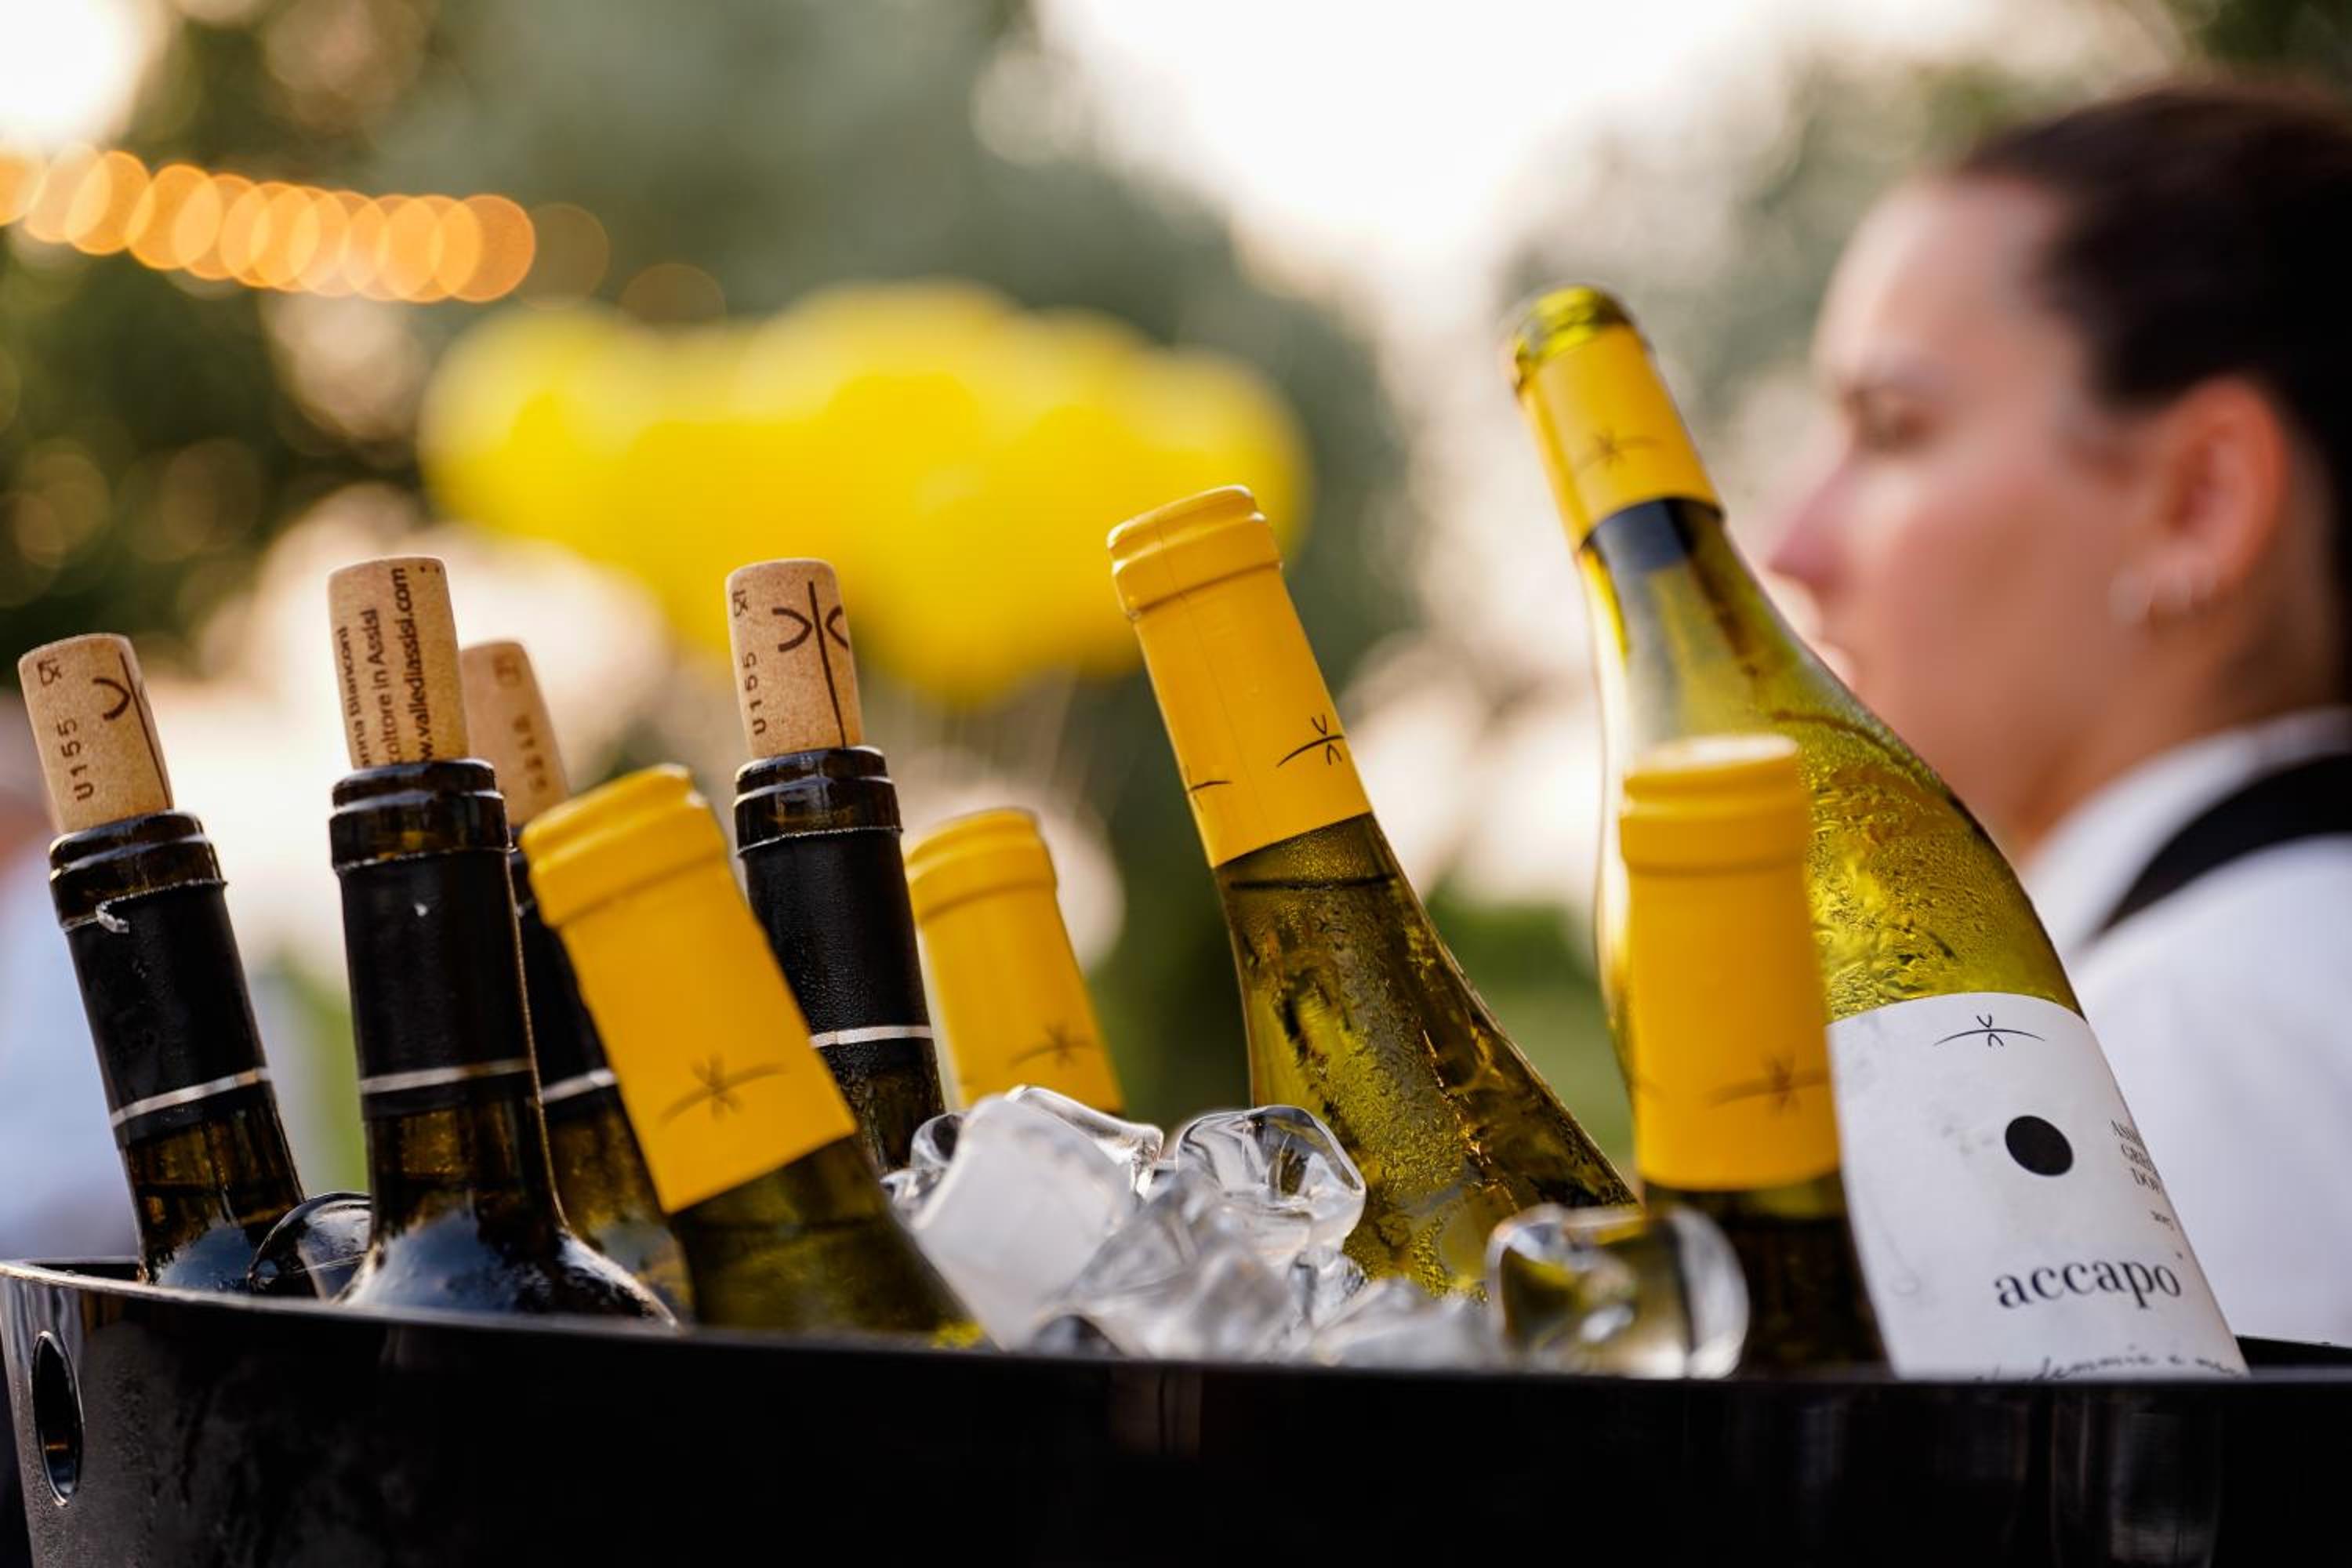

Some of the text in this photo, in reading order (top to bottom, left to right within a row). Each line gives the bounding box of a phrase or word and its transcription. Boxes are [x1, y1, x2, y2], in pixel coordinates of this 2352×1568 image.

[360, 608, 385, 666] Assisi
[338, 626, 361, 716] Bianconi
[372, 670, 390, 691] in
[1994, 1259, 2182, 1311] accapo
